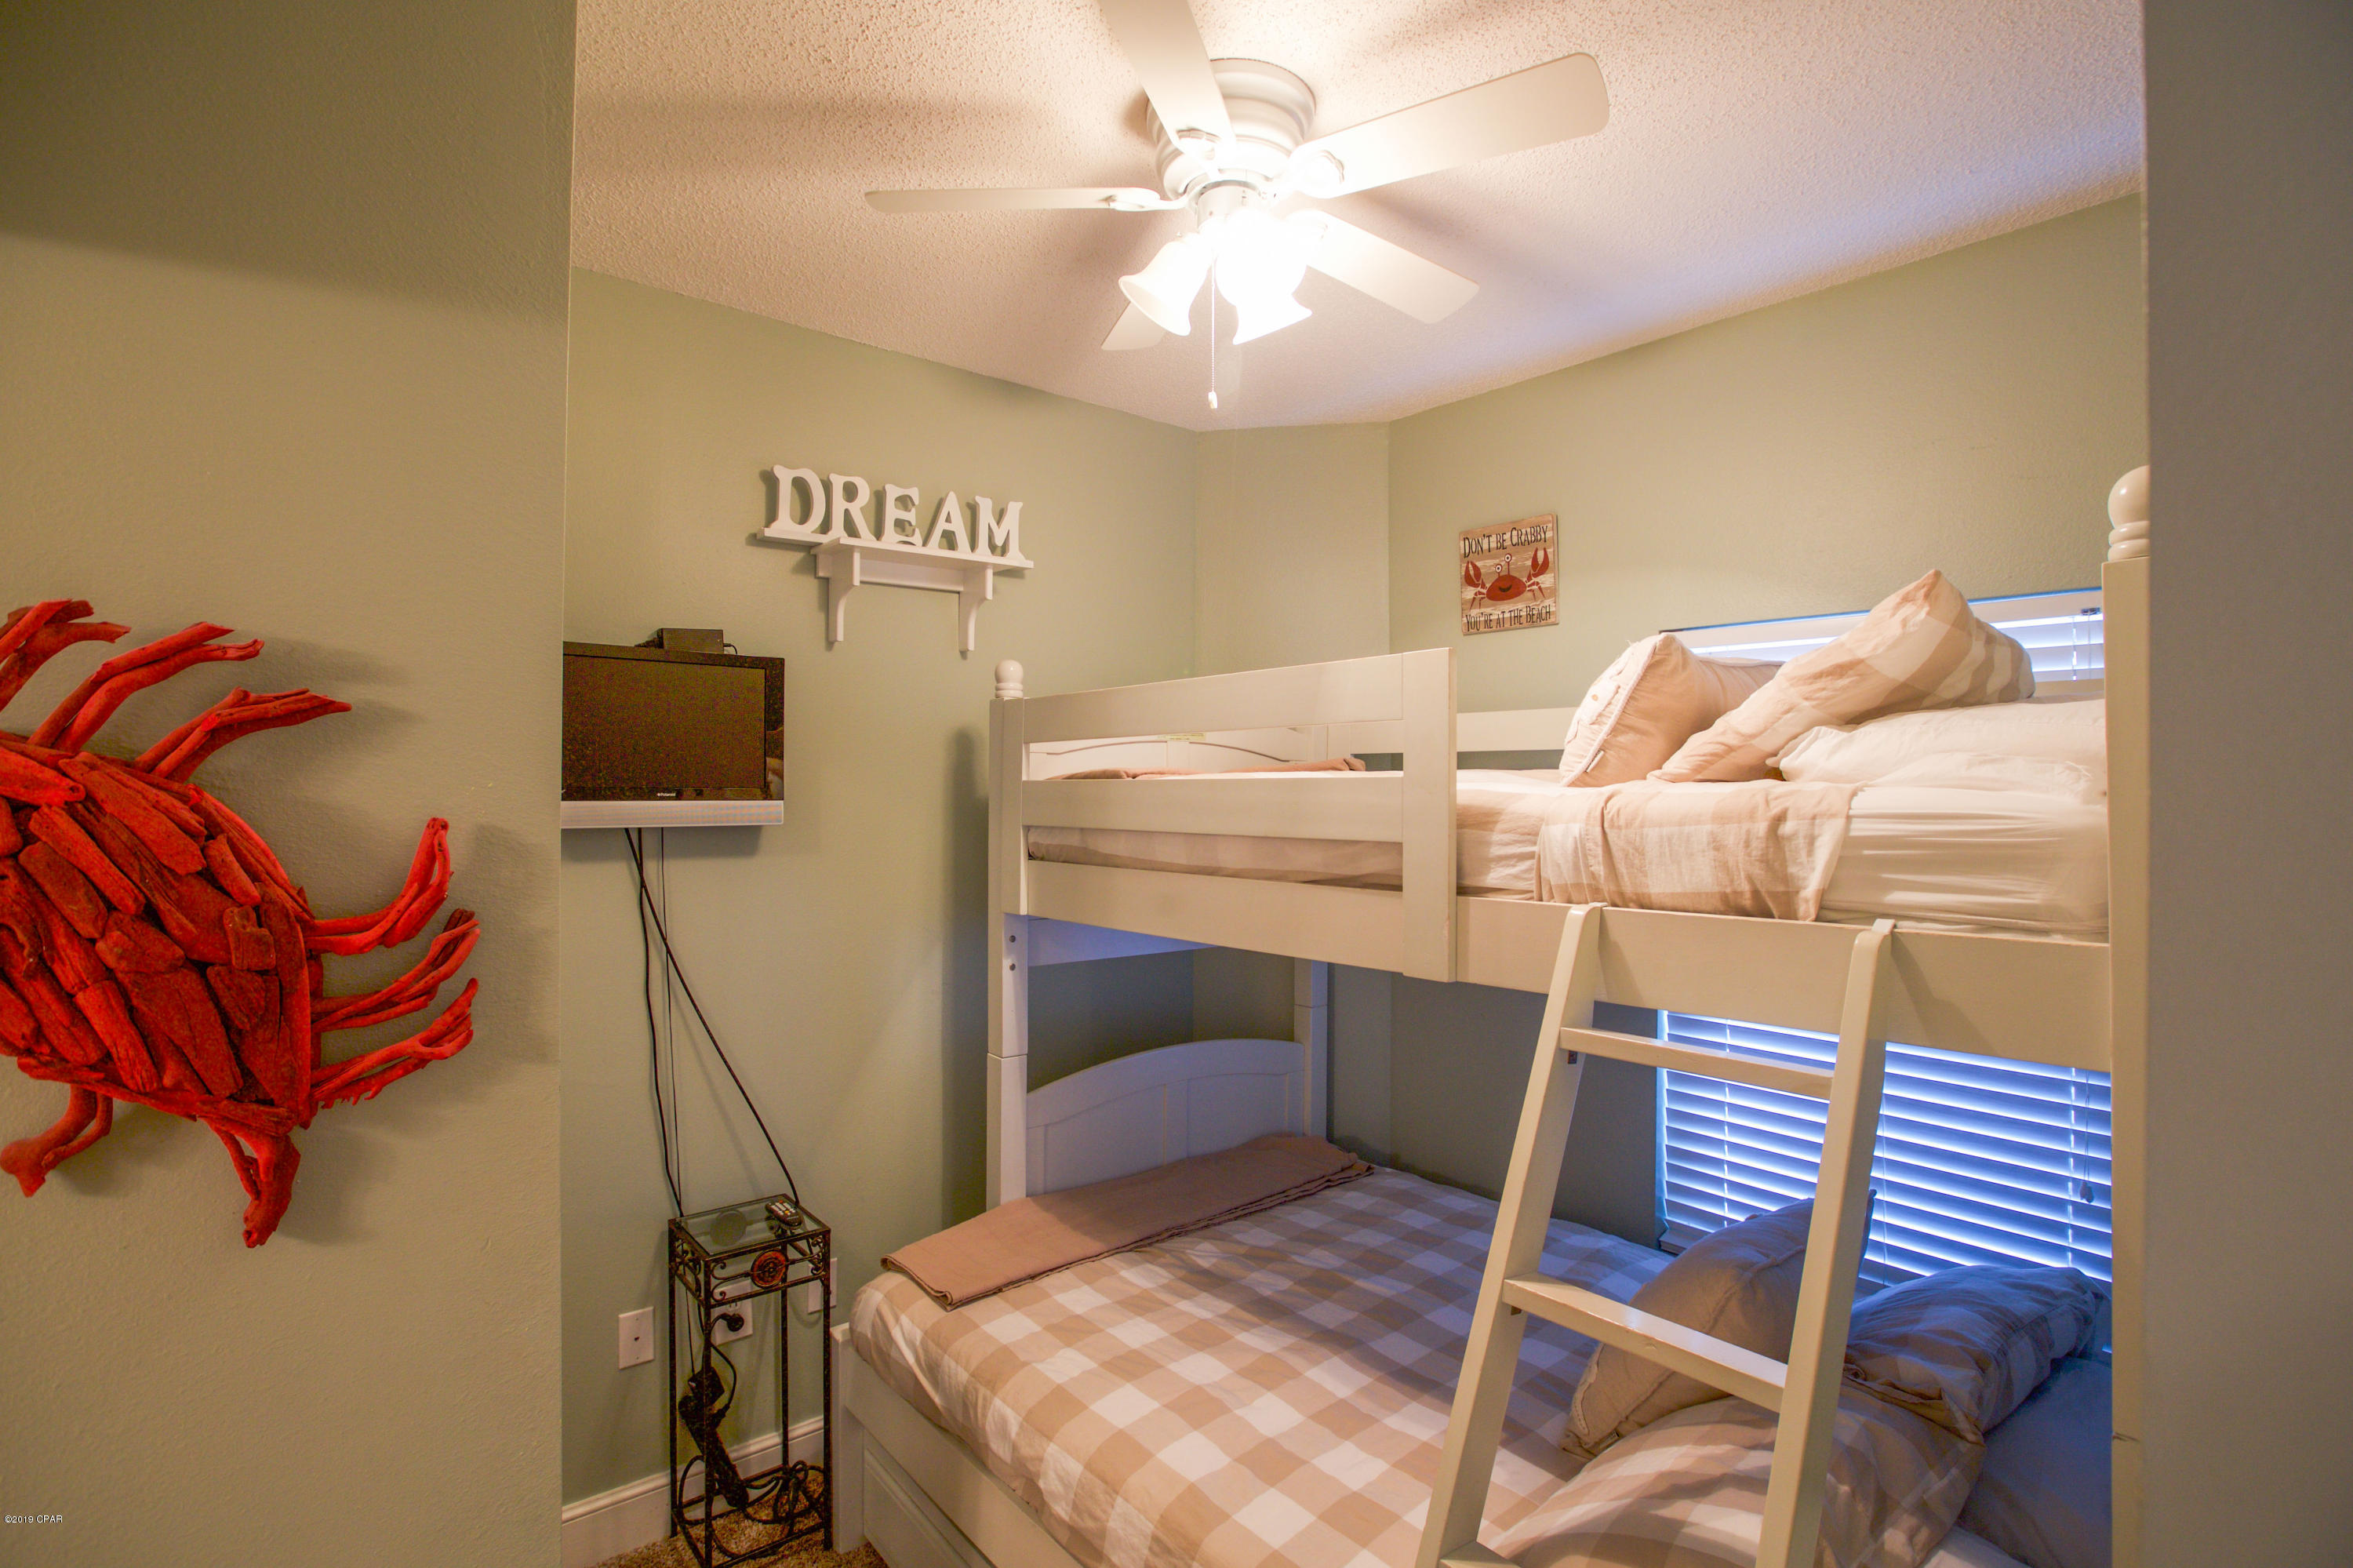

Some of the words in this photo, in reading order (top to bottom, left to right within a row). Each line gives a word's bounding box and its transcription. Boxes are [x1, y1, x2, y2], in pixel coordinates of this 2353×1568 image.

[769, 464, 1026, 560] DREAM
[1463, 533, 1492, 558] DON'T
[1496, 533, 1507, 550] BE
[1510, 525, 1548, 547] CRABBY
[1465, 612, 1493, 632] YOU'RE
[1497, 611, 1506, 628] AT
[1509, 608, 1523, 626] THE
[1526, 604, 1551, 624] BEACH
